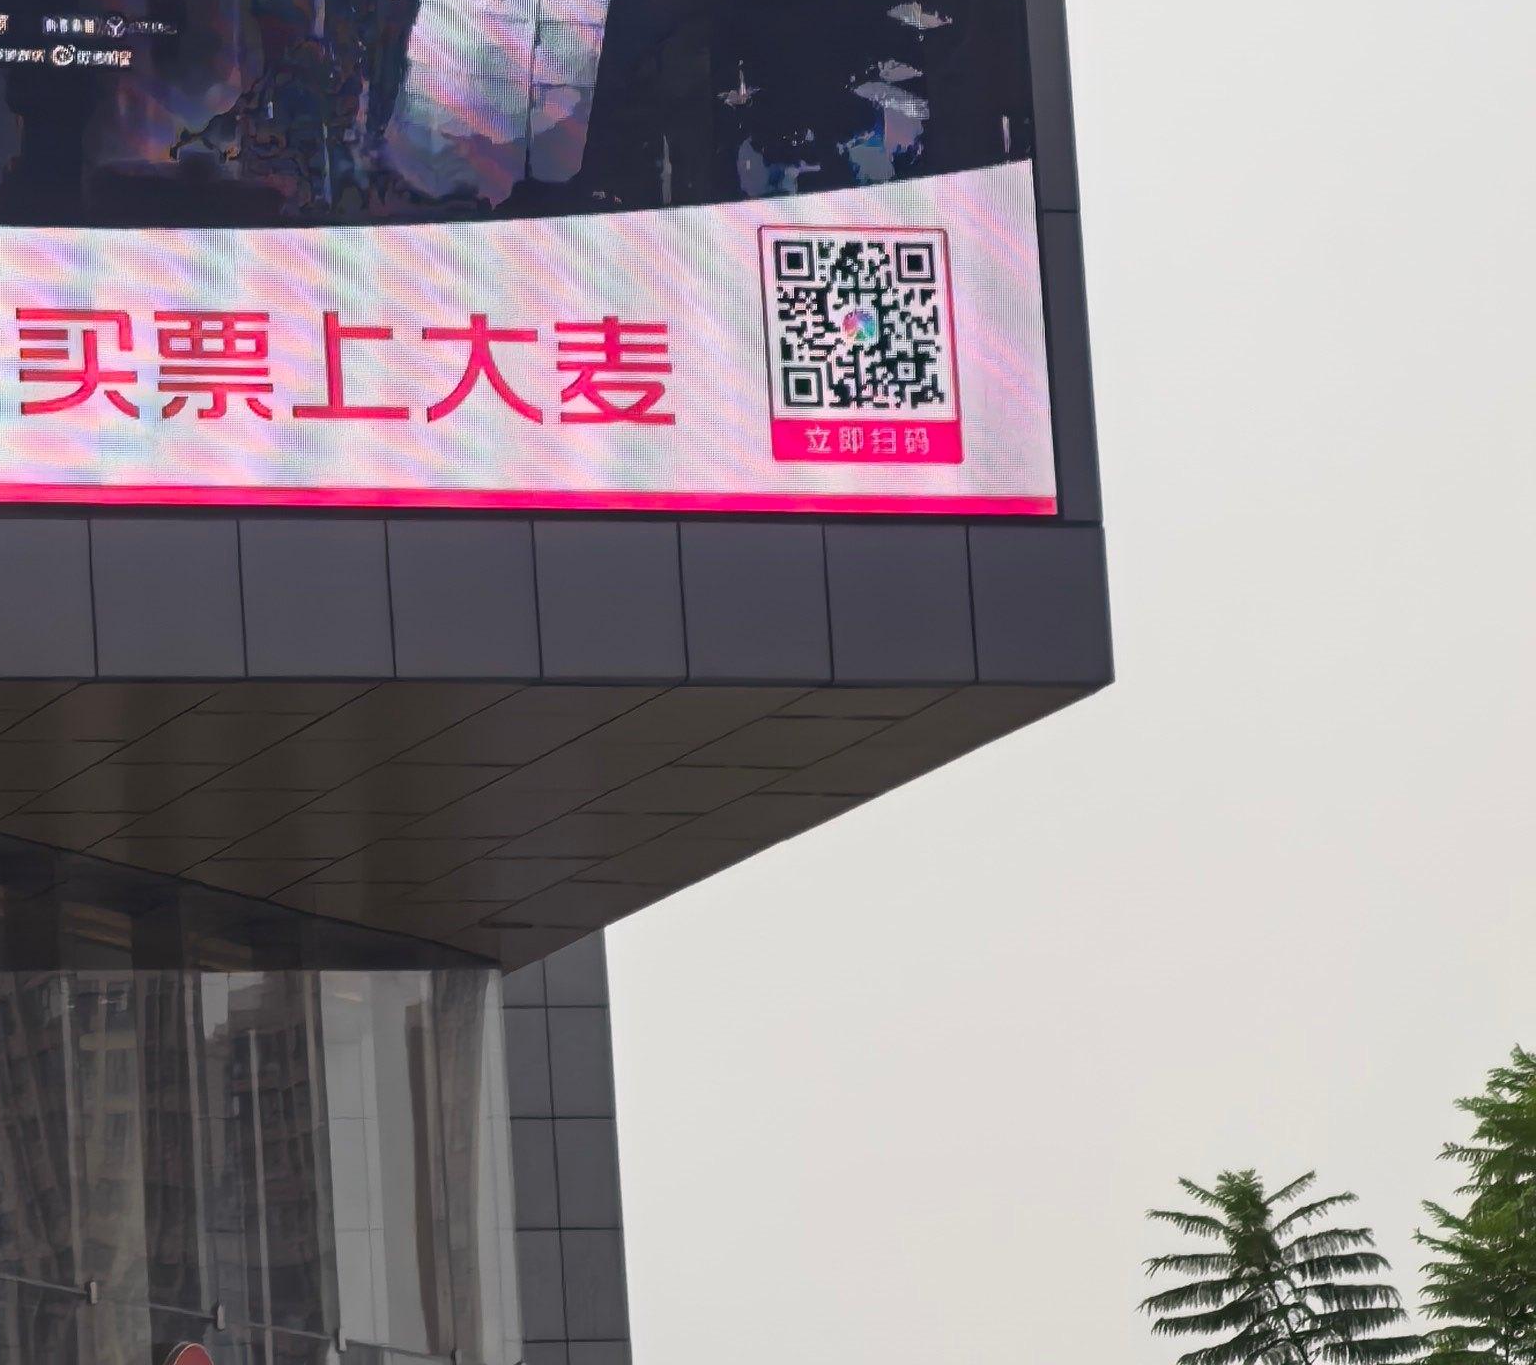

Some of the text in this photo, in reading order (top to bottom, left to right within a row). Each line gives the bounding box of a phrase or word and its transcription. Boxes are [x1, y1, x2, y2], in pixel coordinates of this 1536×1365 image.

[15, 306, 676, 426] 买票上大麦
[804, 424, 932, 457] 立即扫码
